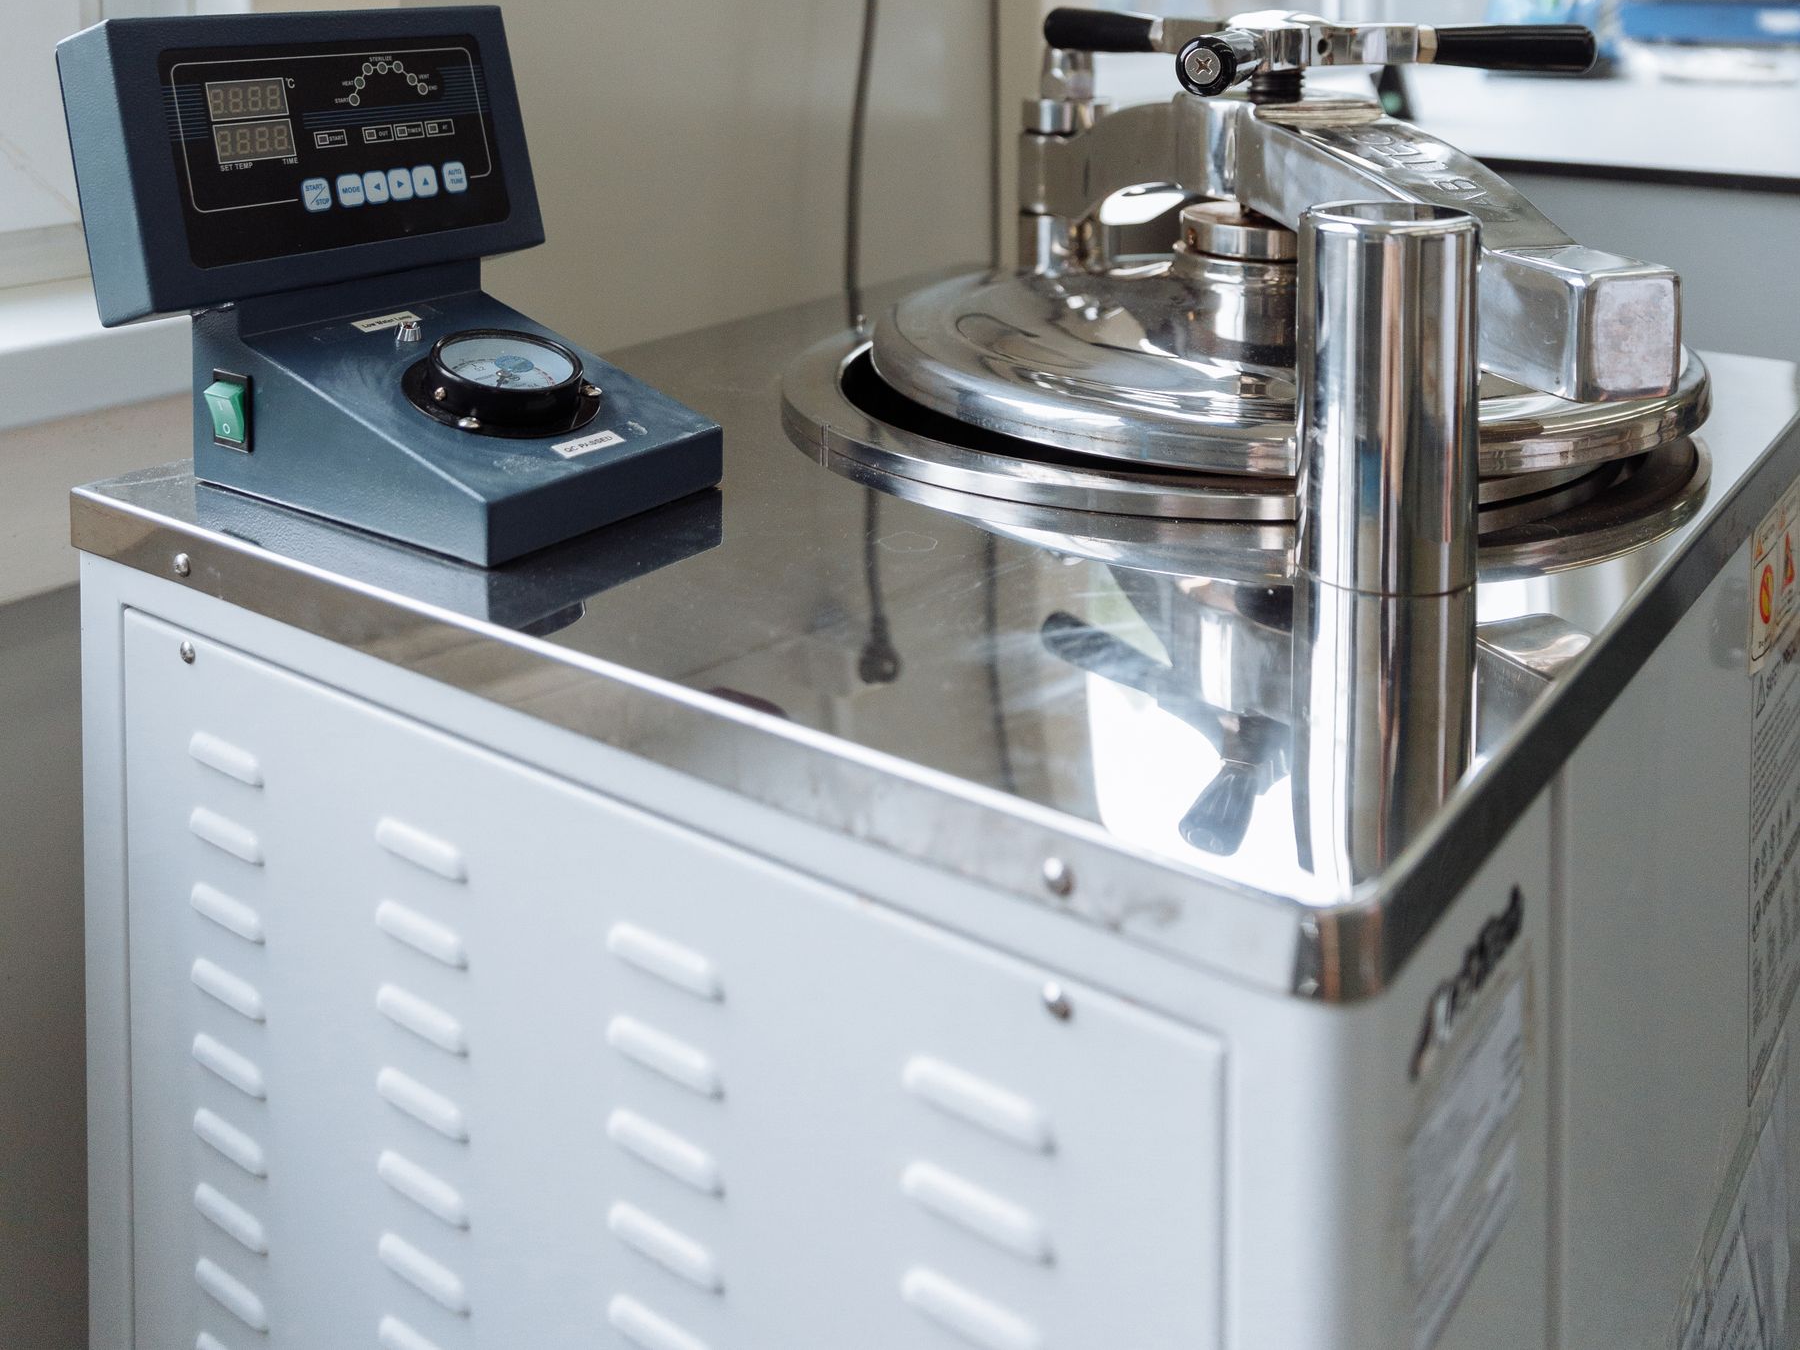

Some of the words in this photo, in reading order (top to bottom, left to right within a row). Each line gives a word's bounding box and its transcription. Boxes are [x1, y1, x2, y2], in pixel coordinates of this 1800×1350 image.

[368, 55, 393, 63] STERILIZE
[282, 157, 299, 165] TIME
[219, 163, 233, 172] SET
[234, 161, 254, 170] TEMP
[447, 168, 462, 176] AUTO
[305, 183, 324, 192] START
[342, 186, 361, 195] MODE
[315, 198, 330, 206] STOP
[578, 435, 614, 448] PASSED
